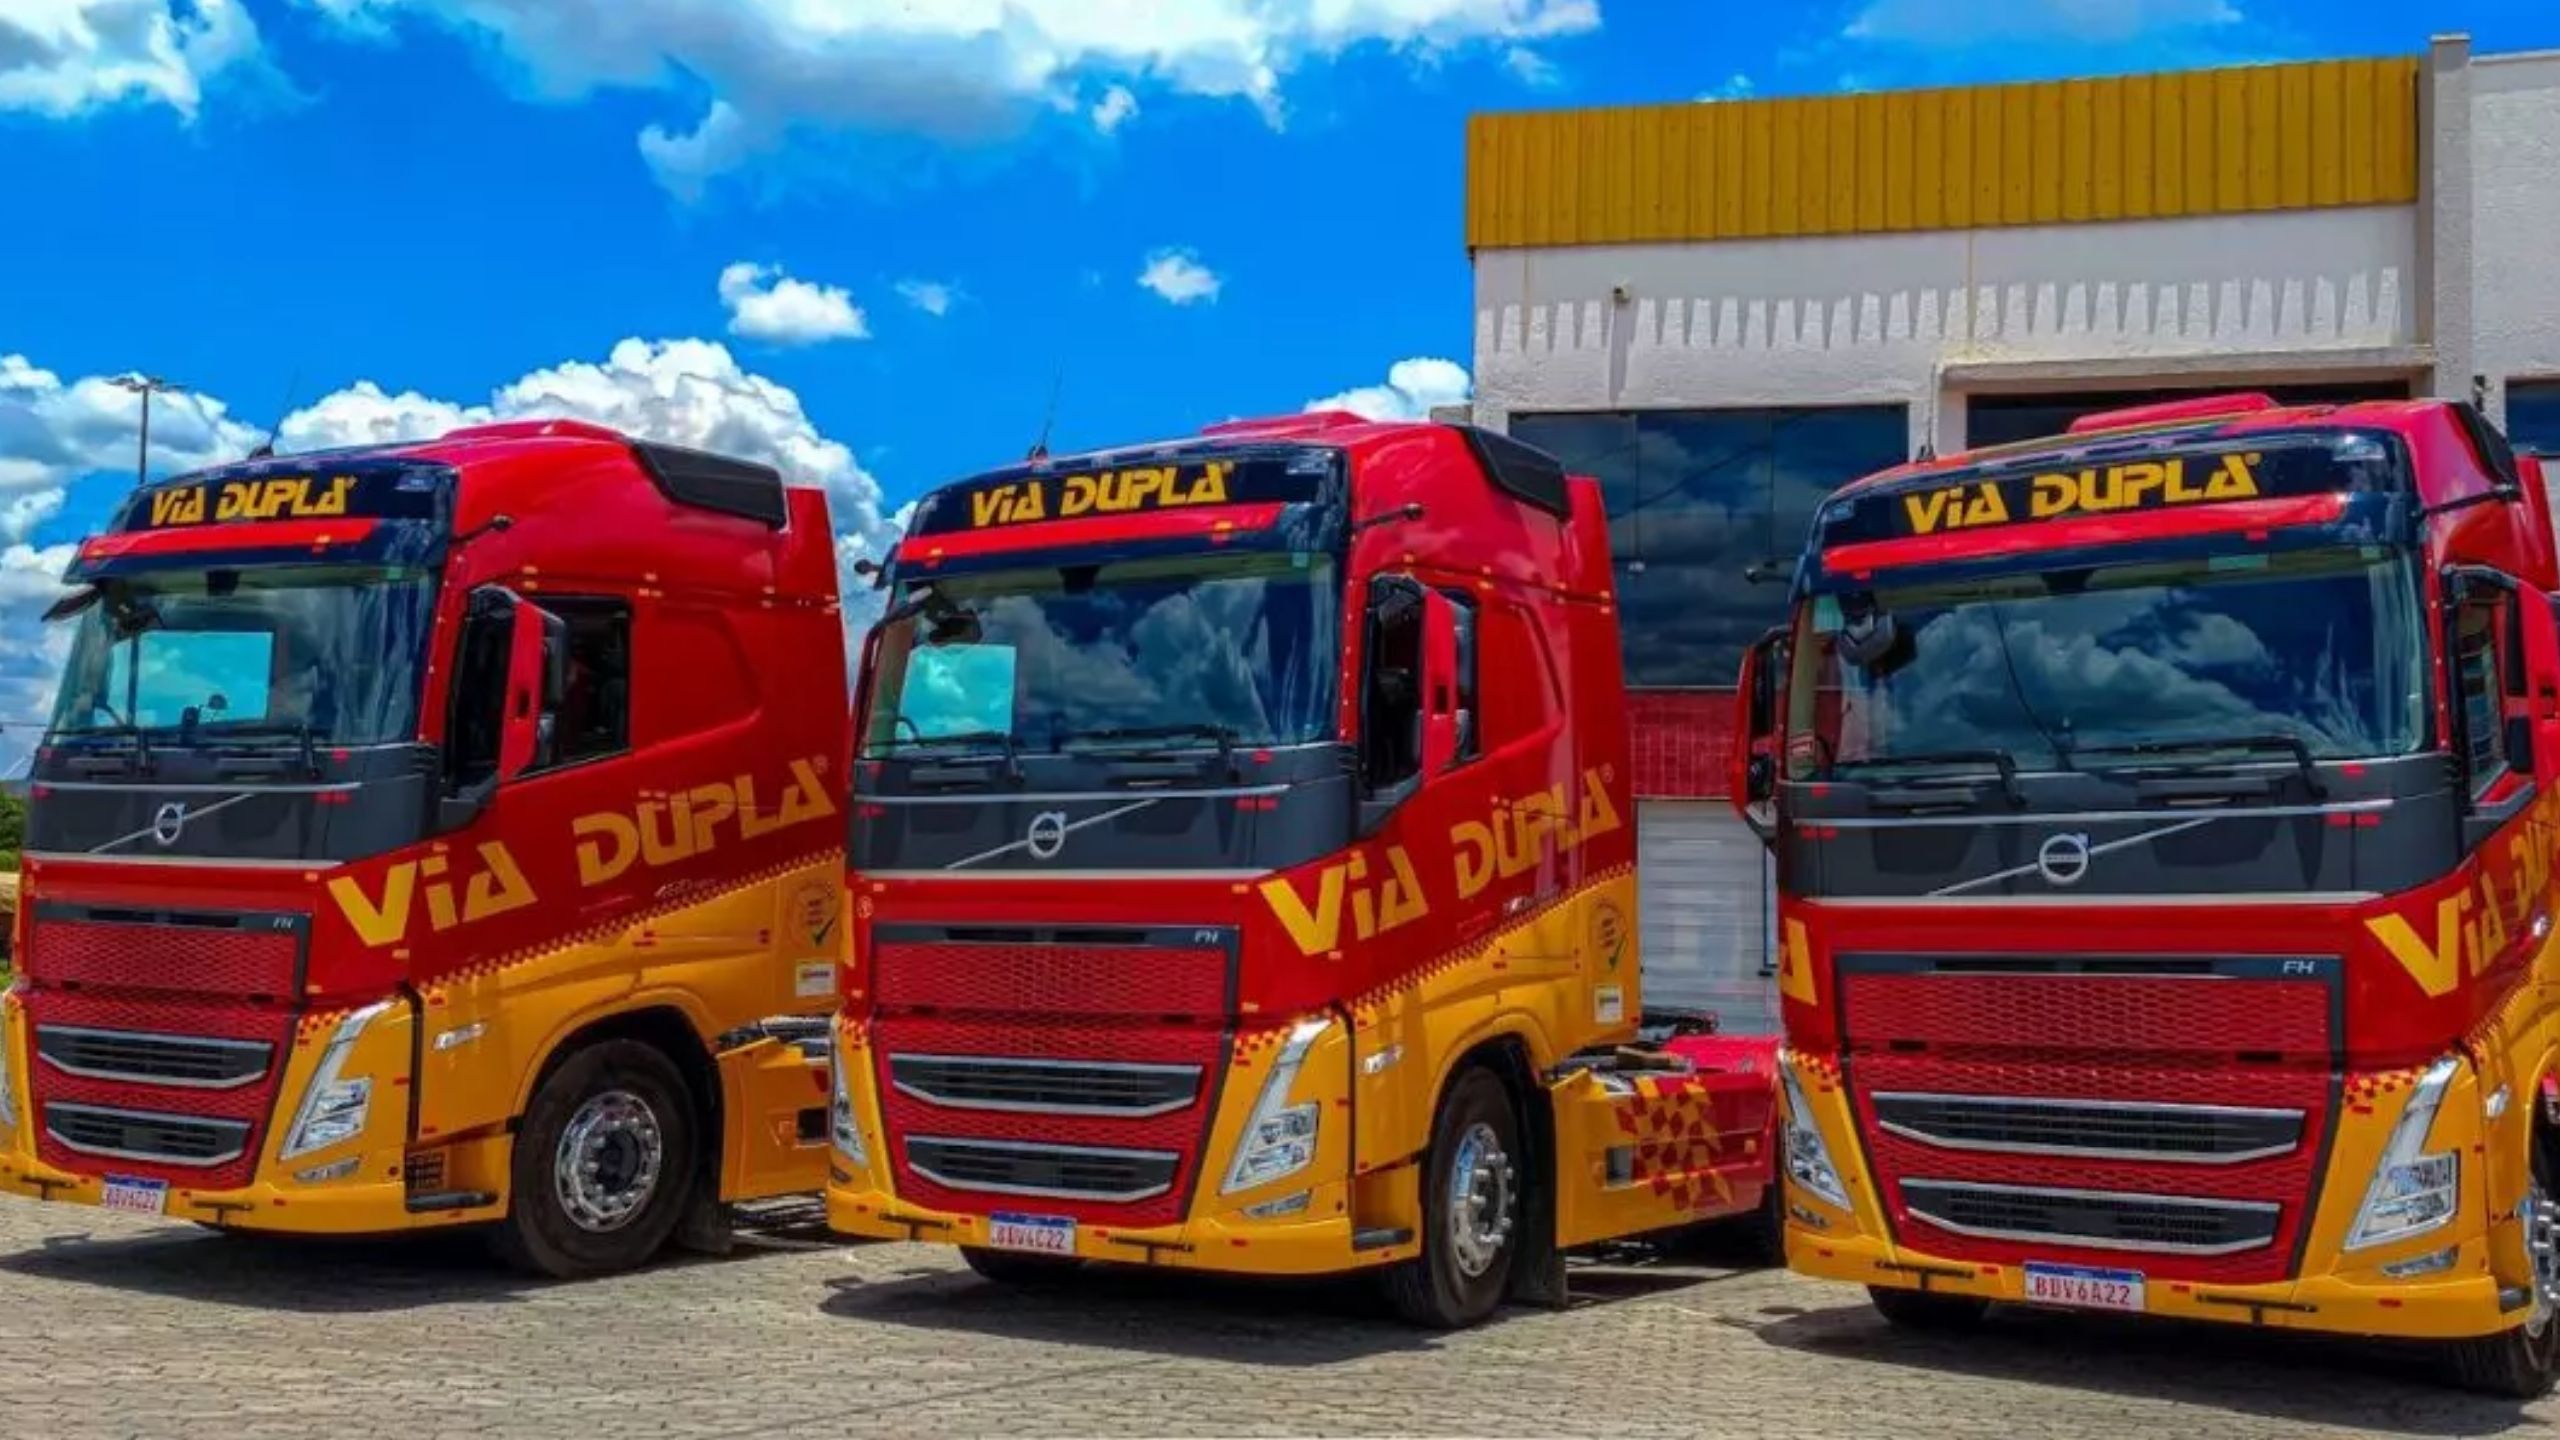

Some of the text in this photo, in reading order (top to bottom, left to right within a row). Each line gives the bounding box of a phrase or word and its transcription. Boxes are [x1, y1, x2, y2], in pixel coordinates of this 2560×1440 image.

[1060, 461, 1227, 516] DUPLA
[2030, 453, 2259, 518] DUPLA
[2283, 960, 2316, 974] FH
[2036, 1276, 2130, 1305] BDV6A22
